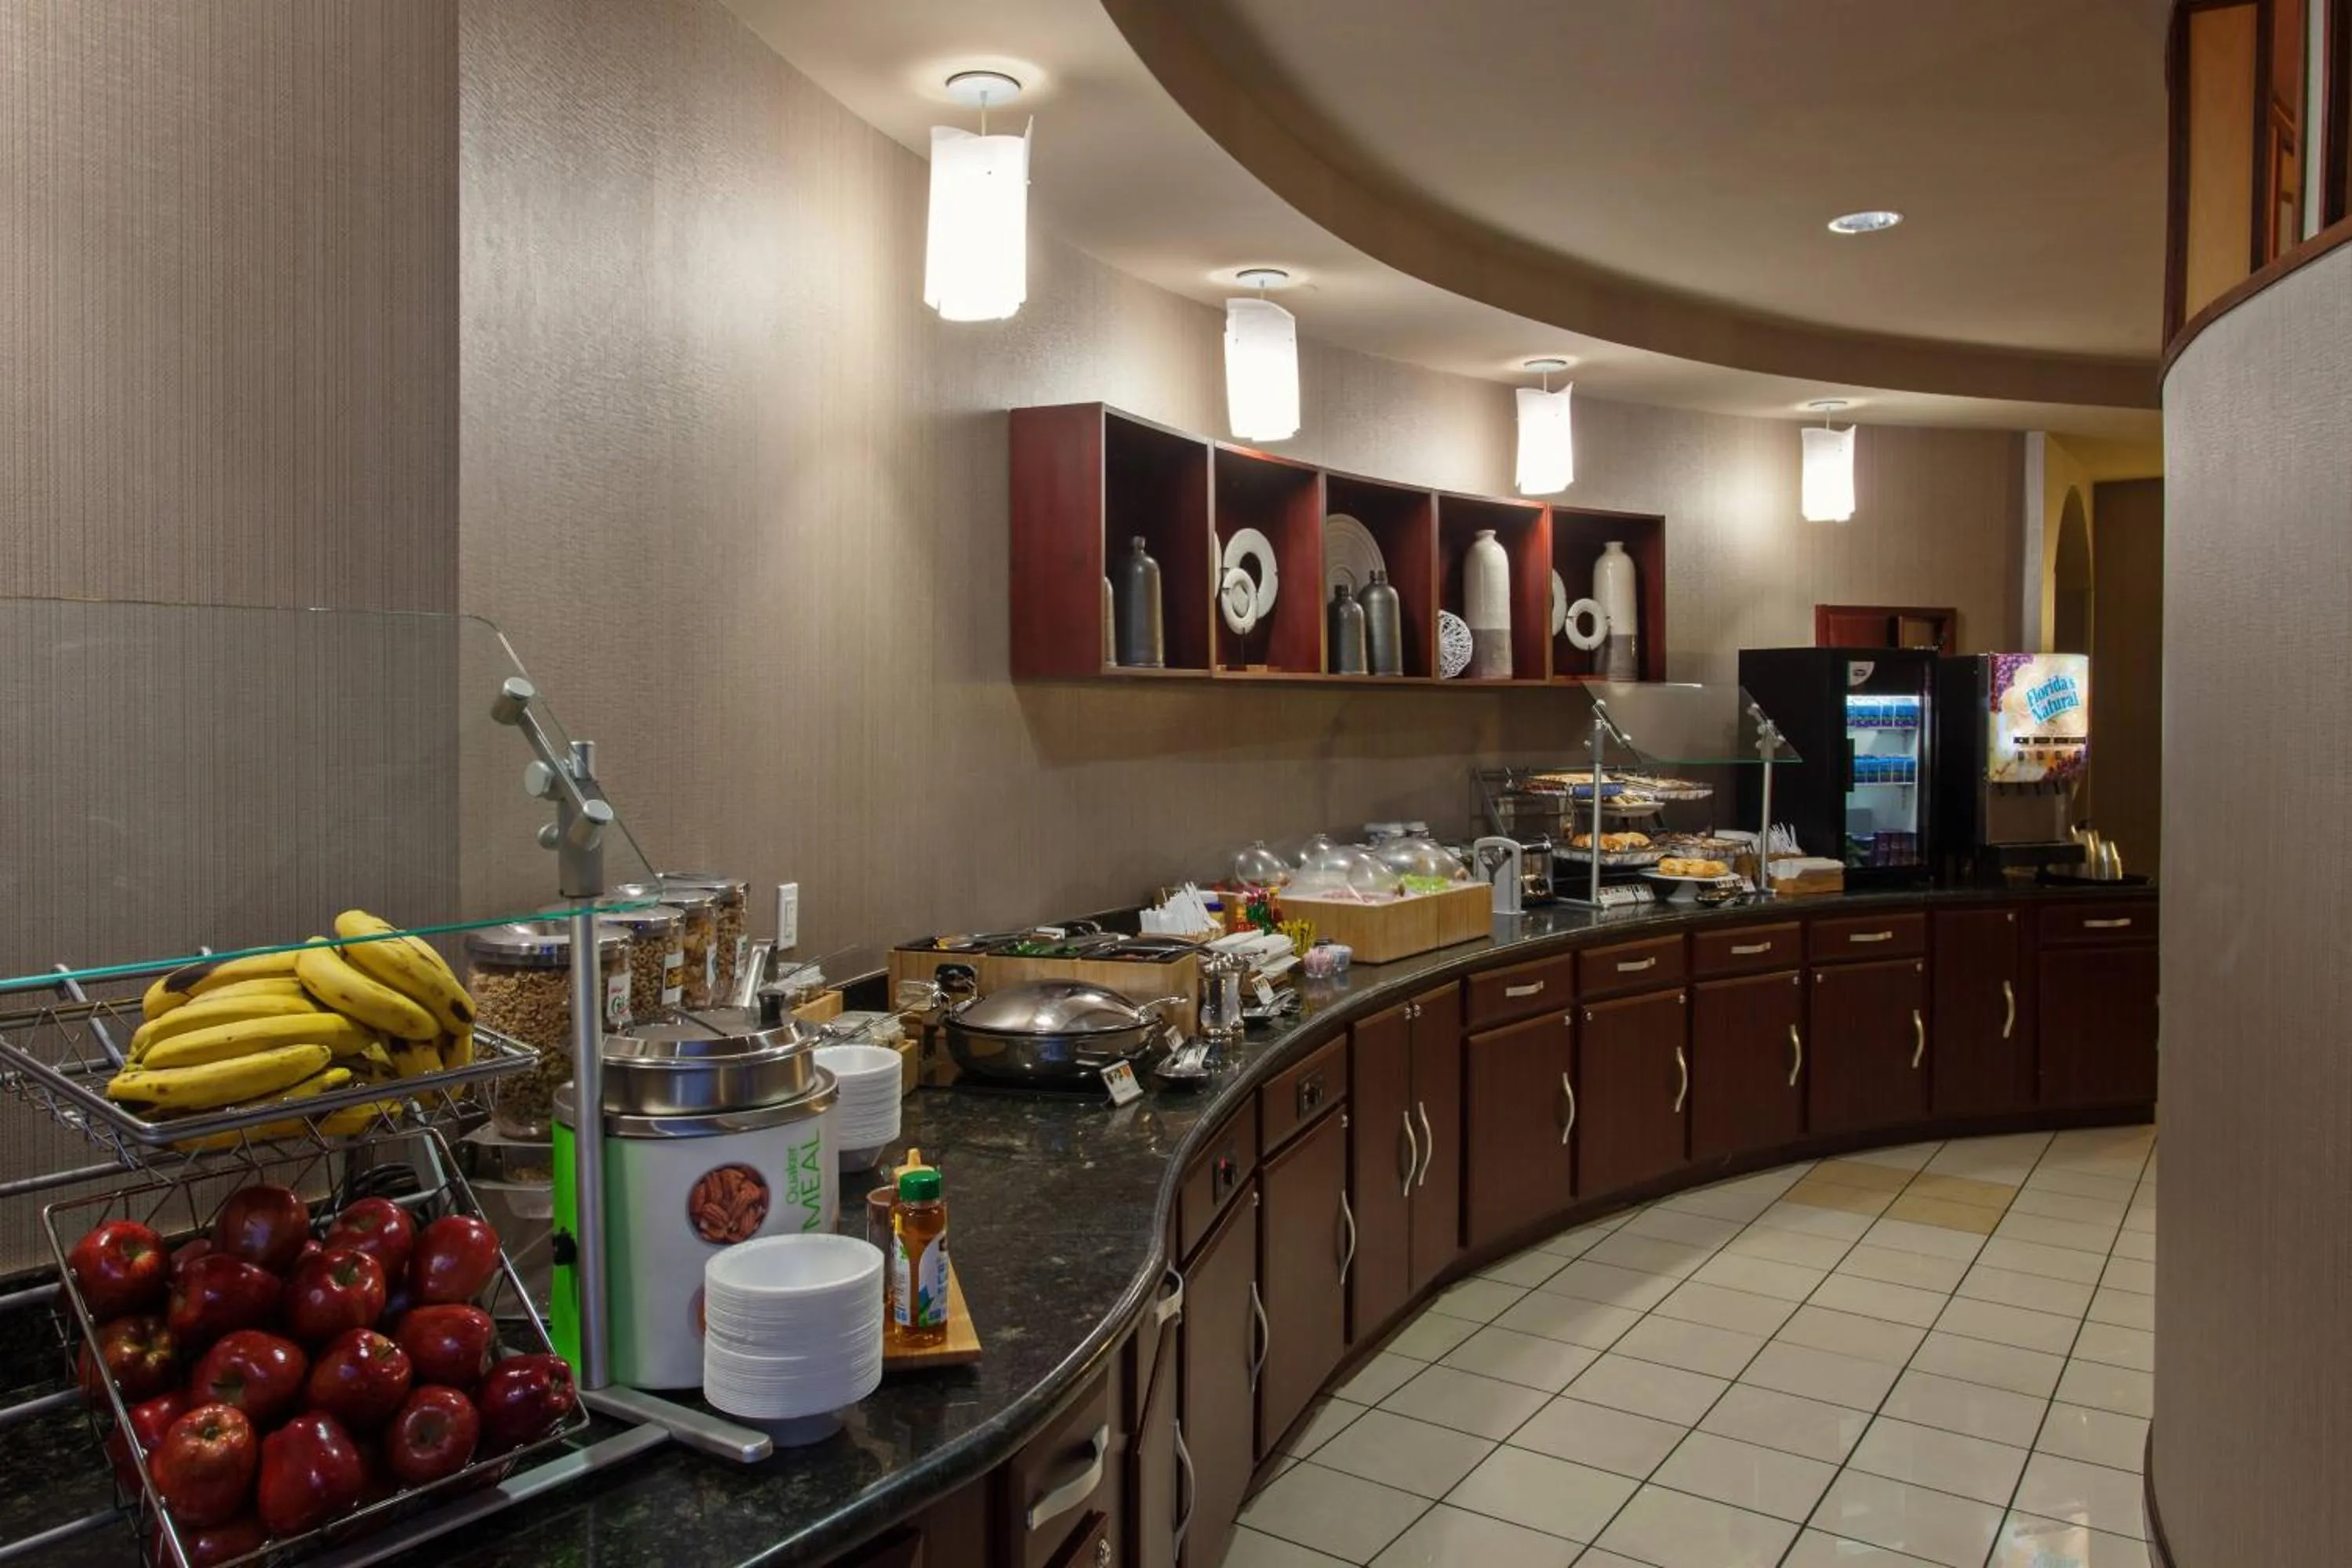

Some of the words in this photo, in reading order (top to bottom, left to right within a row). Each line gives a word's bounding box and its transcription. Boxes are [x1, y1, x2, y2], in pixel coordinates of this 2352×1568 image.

[2031, 691, 2080, 721] Natural
[786, 1145, 799, 1204] Quaker
[800, 1128, 821, 1232] MEAL
